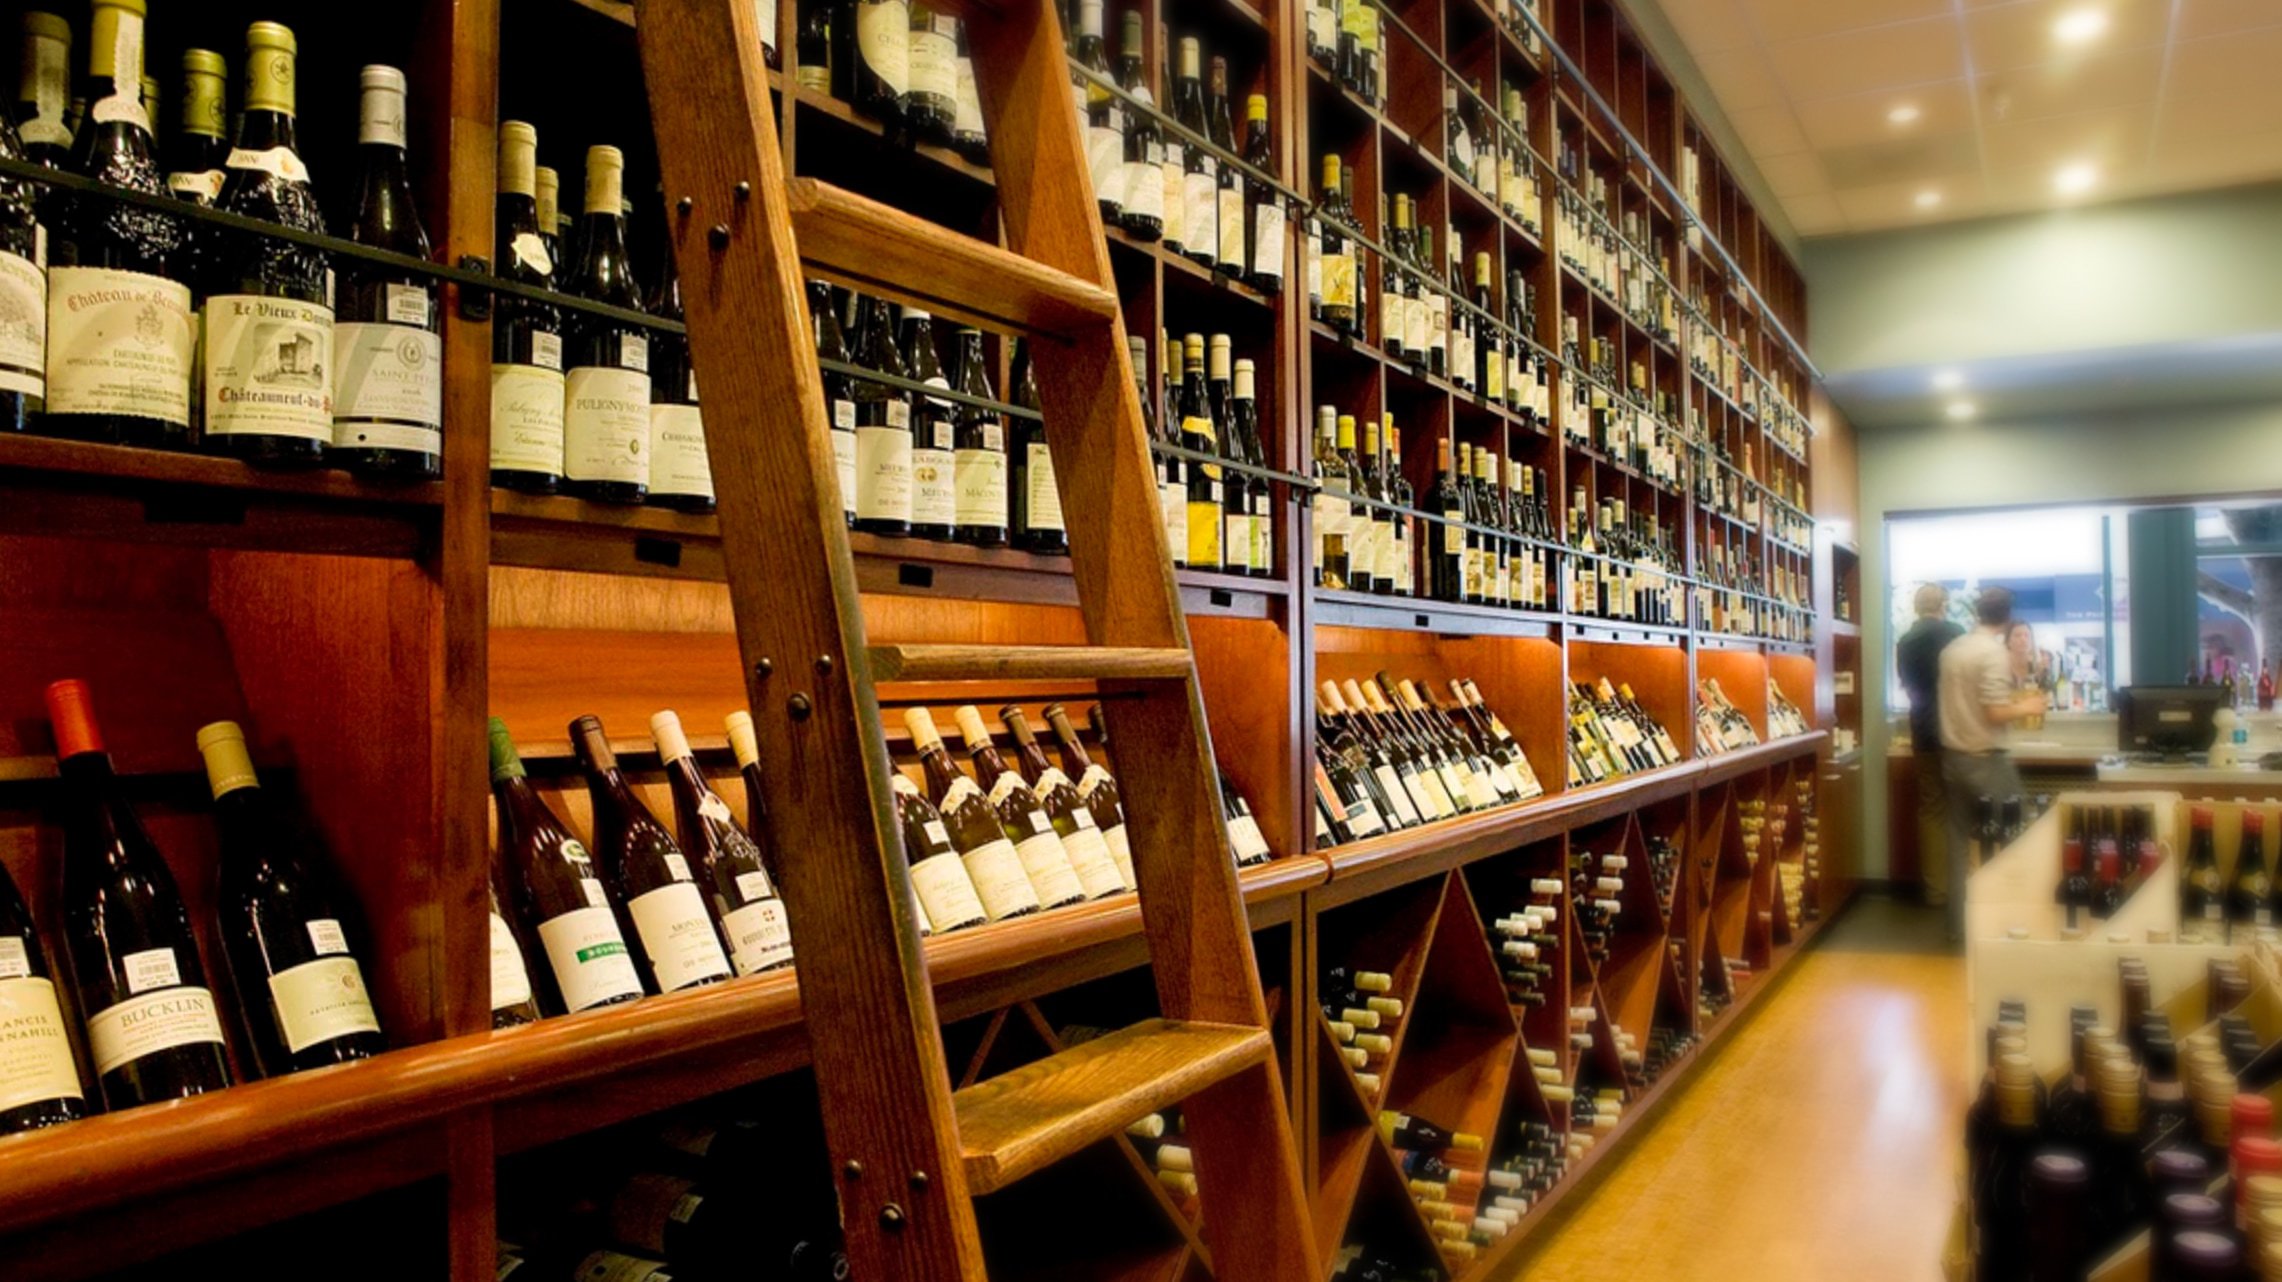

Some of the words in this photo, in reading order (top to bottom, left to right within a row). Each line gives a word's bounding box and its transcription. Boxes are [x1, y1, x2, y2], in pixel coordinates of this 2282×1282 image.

[233, 301, 250, 316] Le
[256, 302, 297, 320] Vieux
[120, 998, 205, 1028] BUCKLIN
